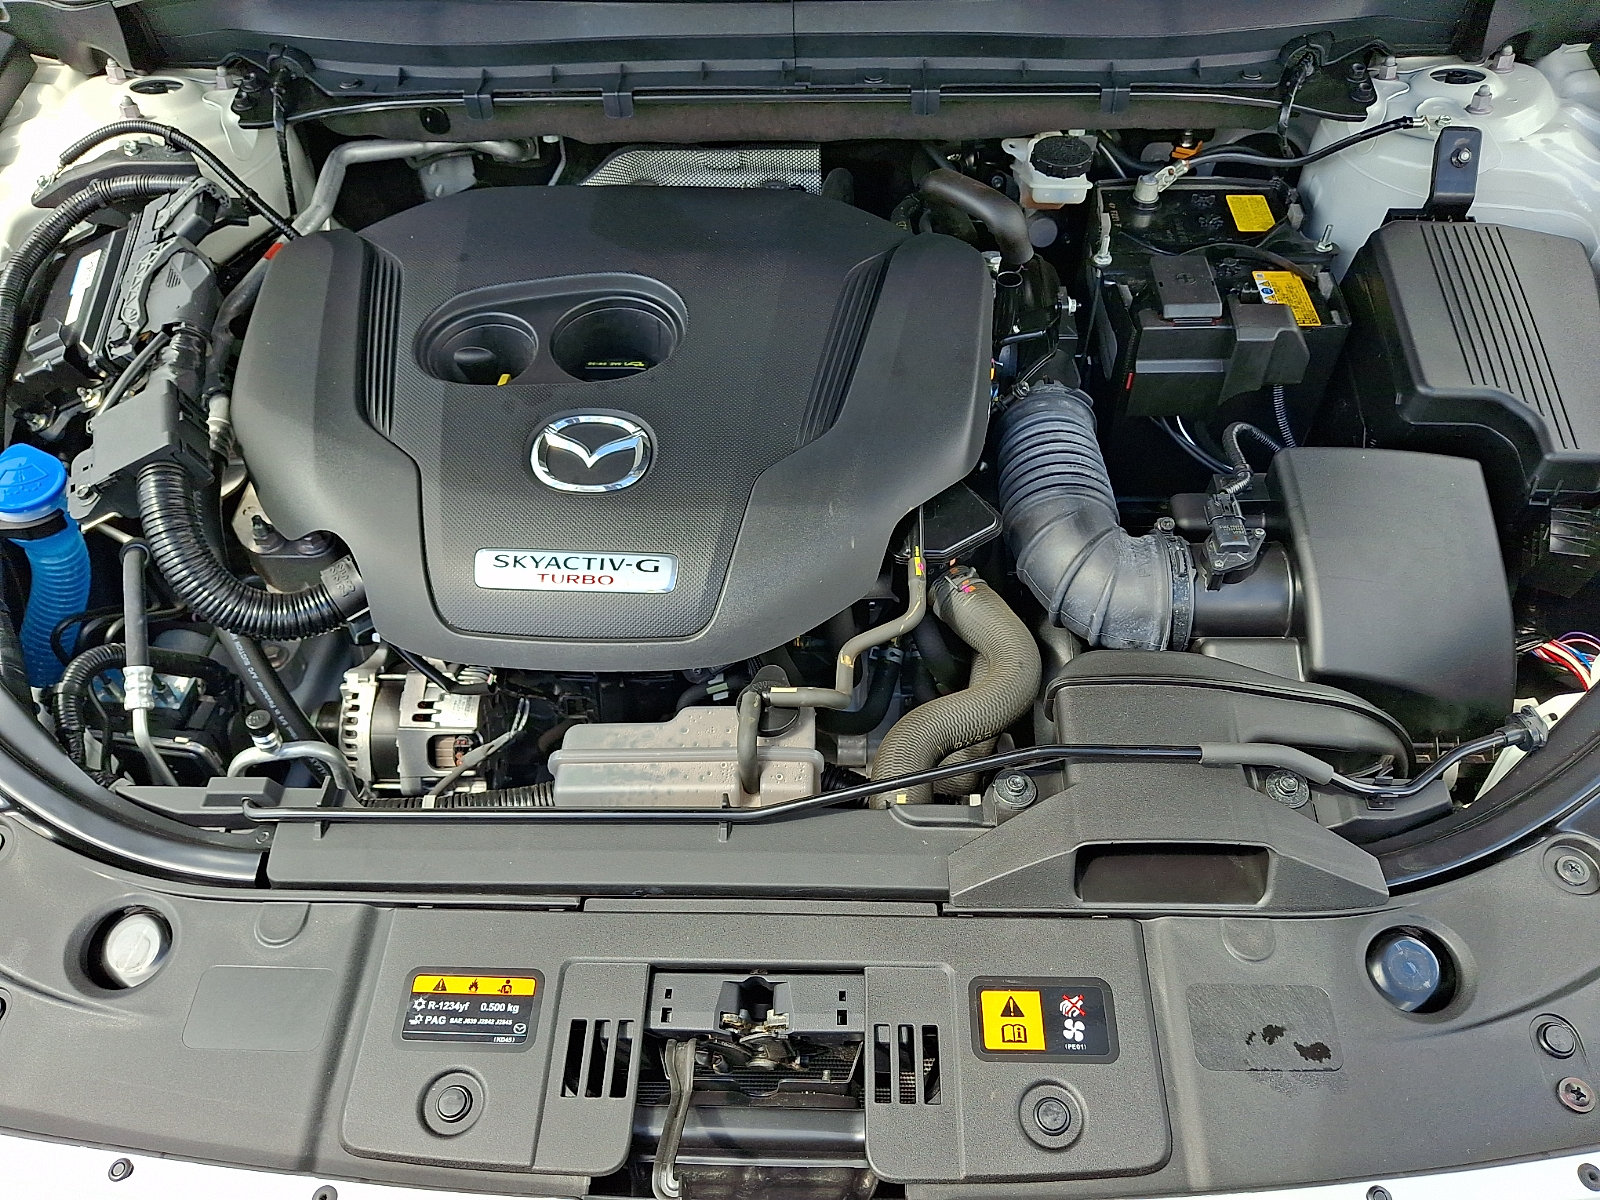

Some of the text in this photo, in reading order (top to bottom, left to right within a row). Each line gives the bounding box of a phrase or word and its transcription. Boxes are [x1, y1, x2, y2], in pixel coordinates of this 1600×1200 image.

[492, 554, 660, 573] SKYACTIV-G
[536, 573, 615, 586] TURBO
[428, 1001, 520, 1013] R-1234yf 0.500 kg
[424, 1016, 446, 1024] PAG
